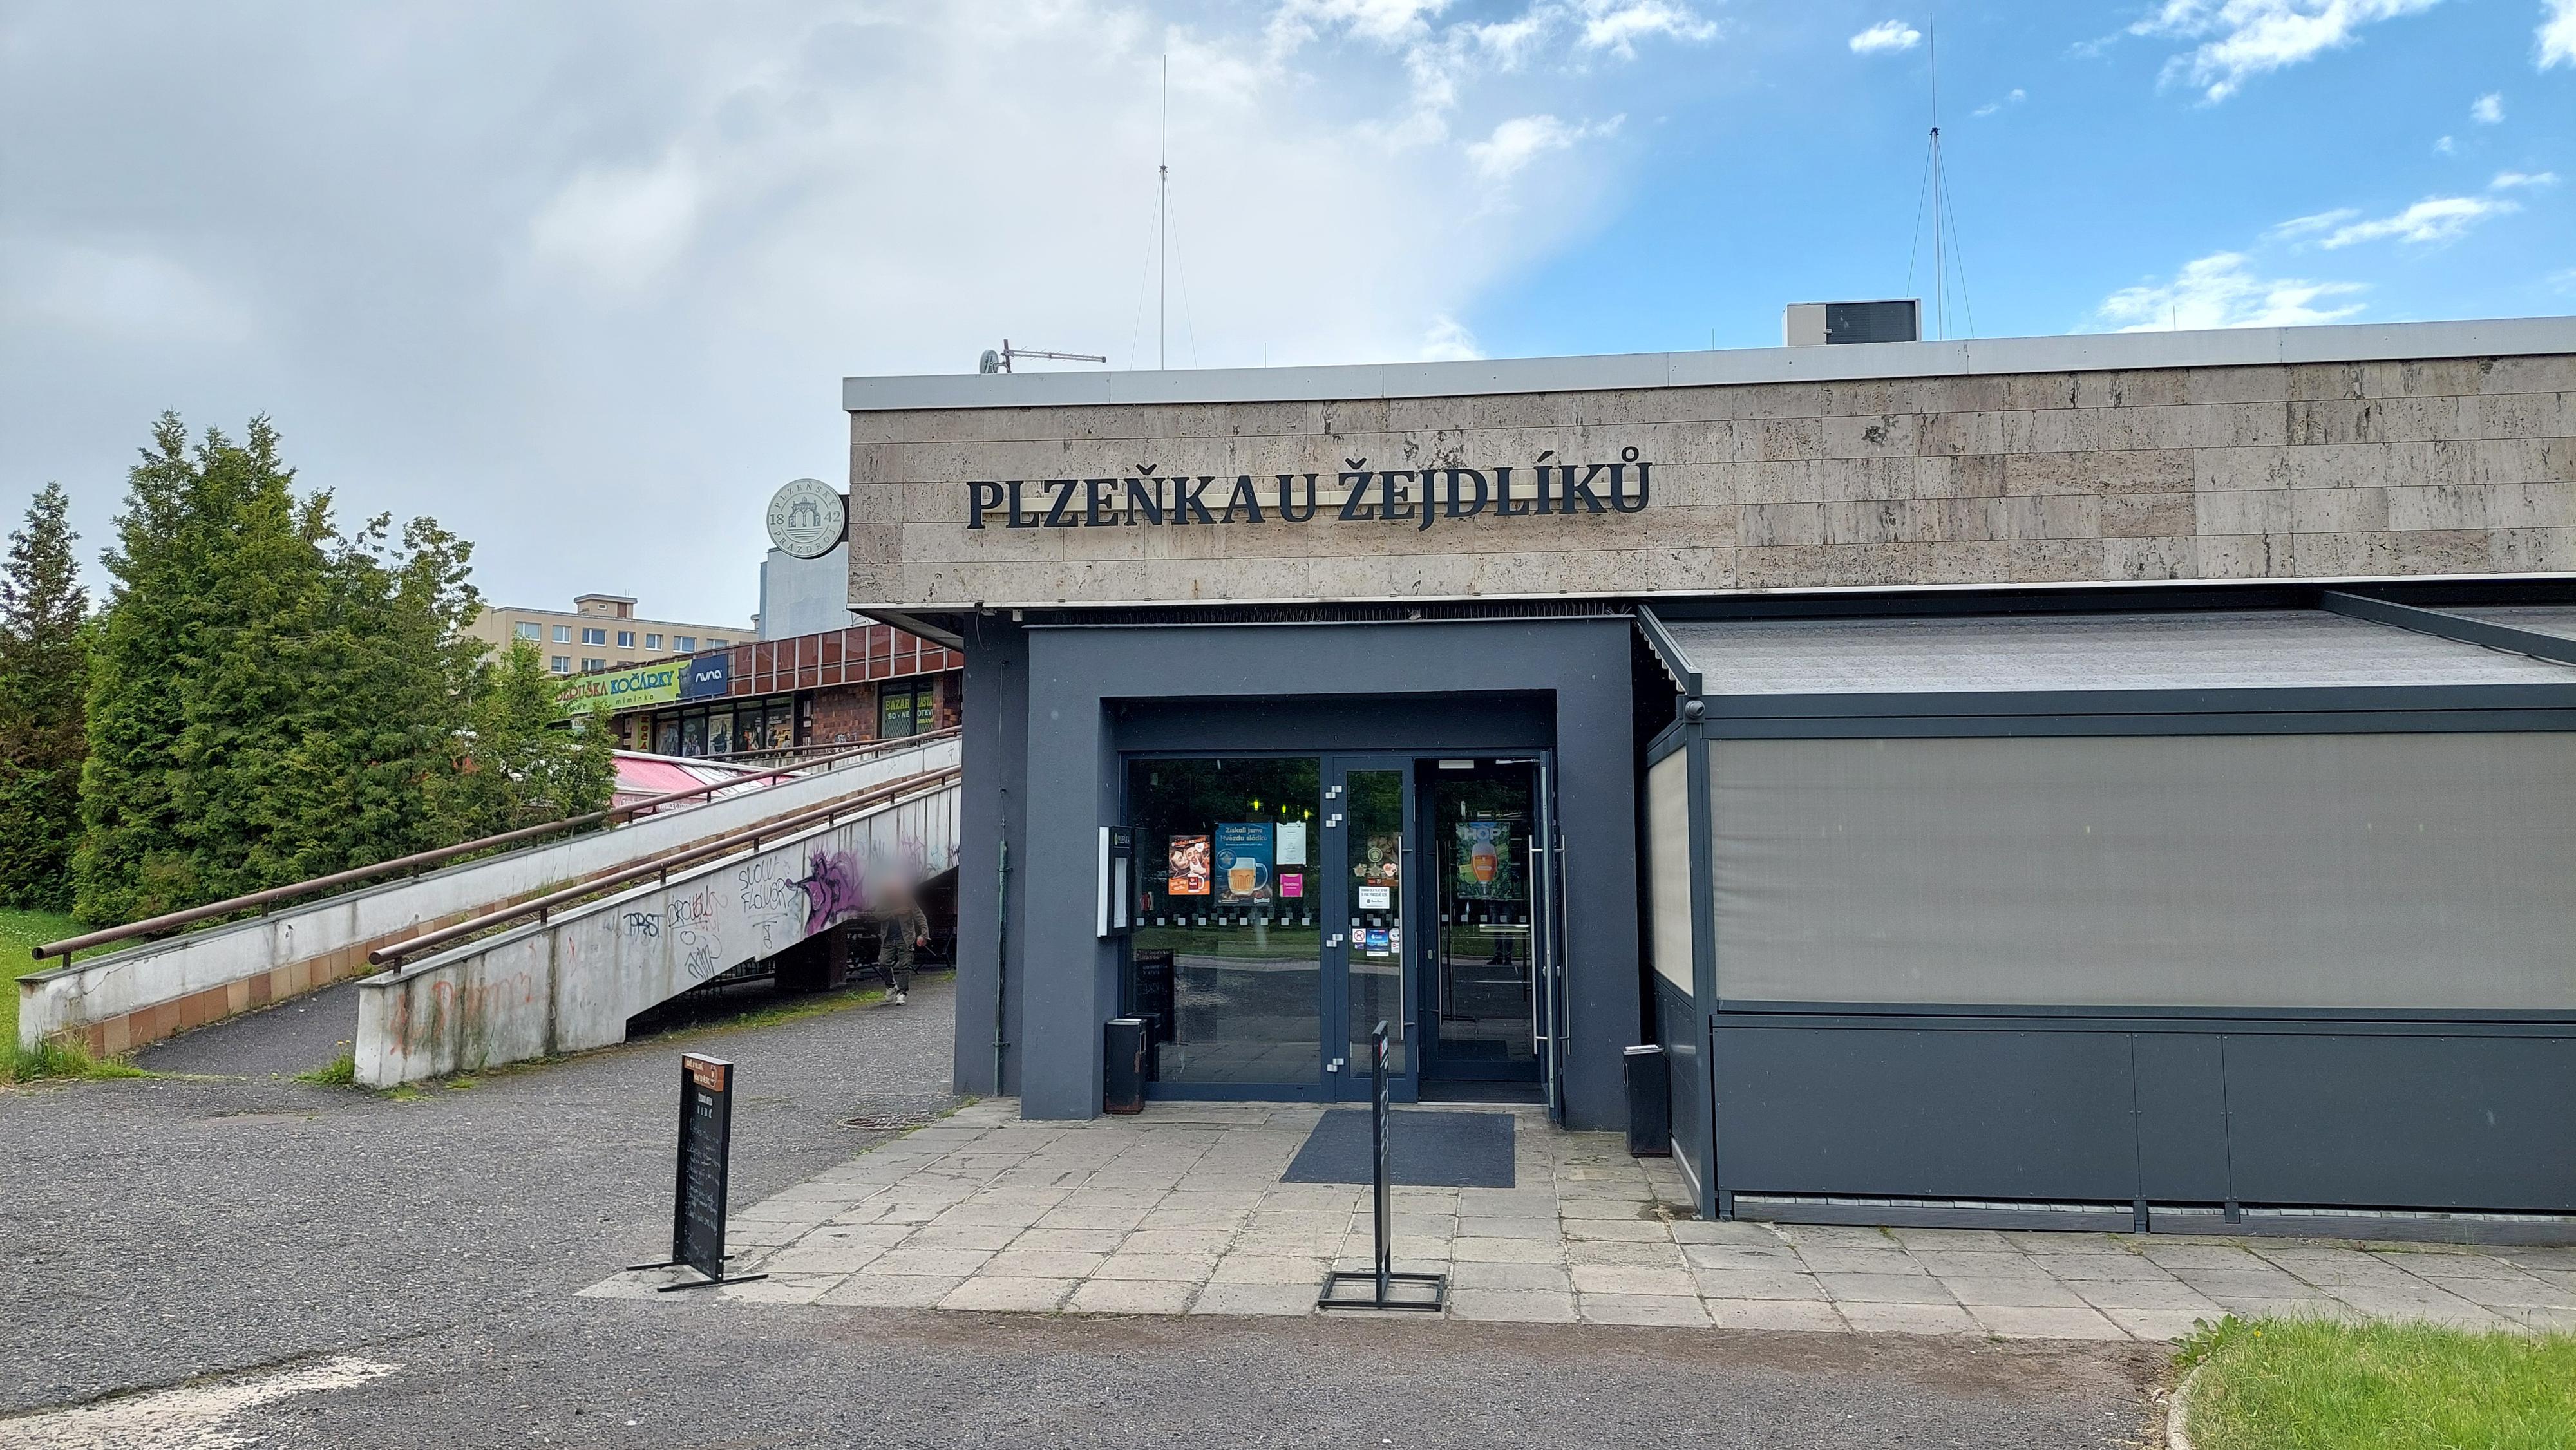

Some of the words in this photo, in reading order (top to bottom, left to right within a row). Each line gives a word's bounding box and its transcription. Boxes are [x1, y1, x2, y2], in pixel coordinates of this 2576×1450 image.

[966, 463, 1266, 530] PLZEŇKA
[1276, 473, 1319, 523] U
[1338, 446, 1653, 532] ŽEJDLÍKŮ
[770, 513, 785, 525] 18
[824, 510, 842, 523] 42
[773, 529, 836, 554] PRAZDROJ
[610, 670, 675, 695] KOČÁRKY
[695, 669, 722, 683] nuna
[616, 694, 654, 705] miminko
[886, 698, 910, 711] BAZAR
